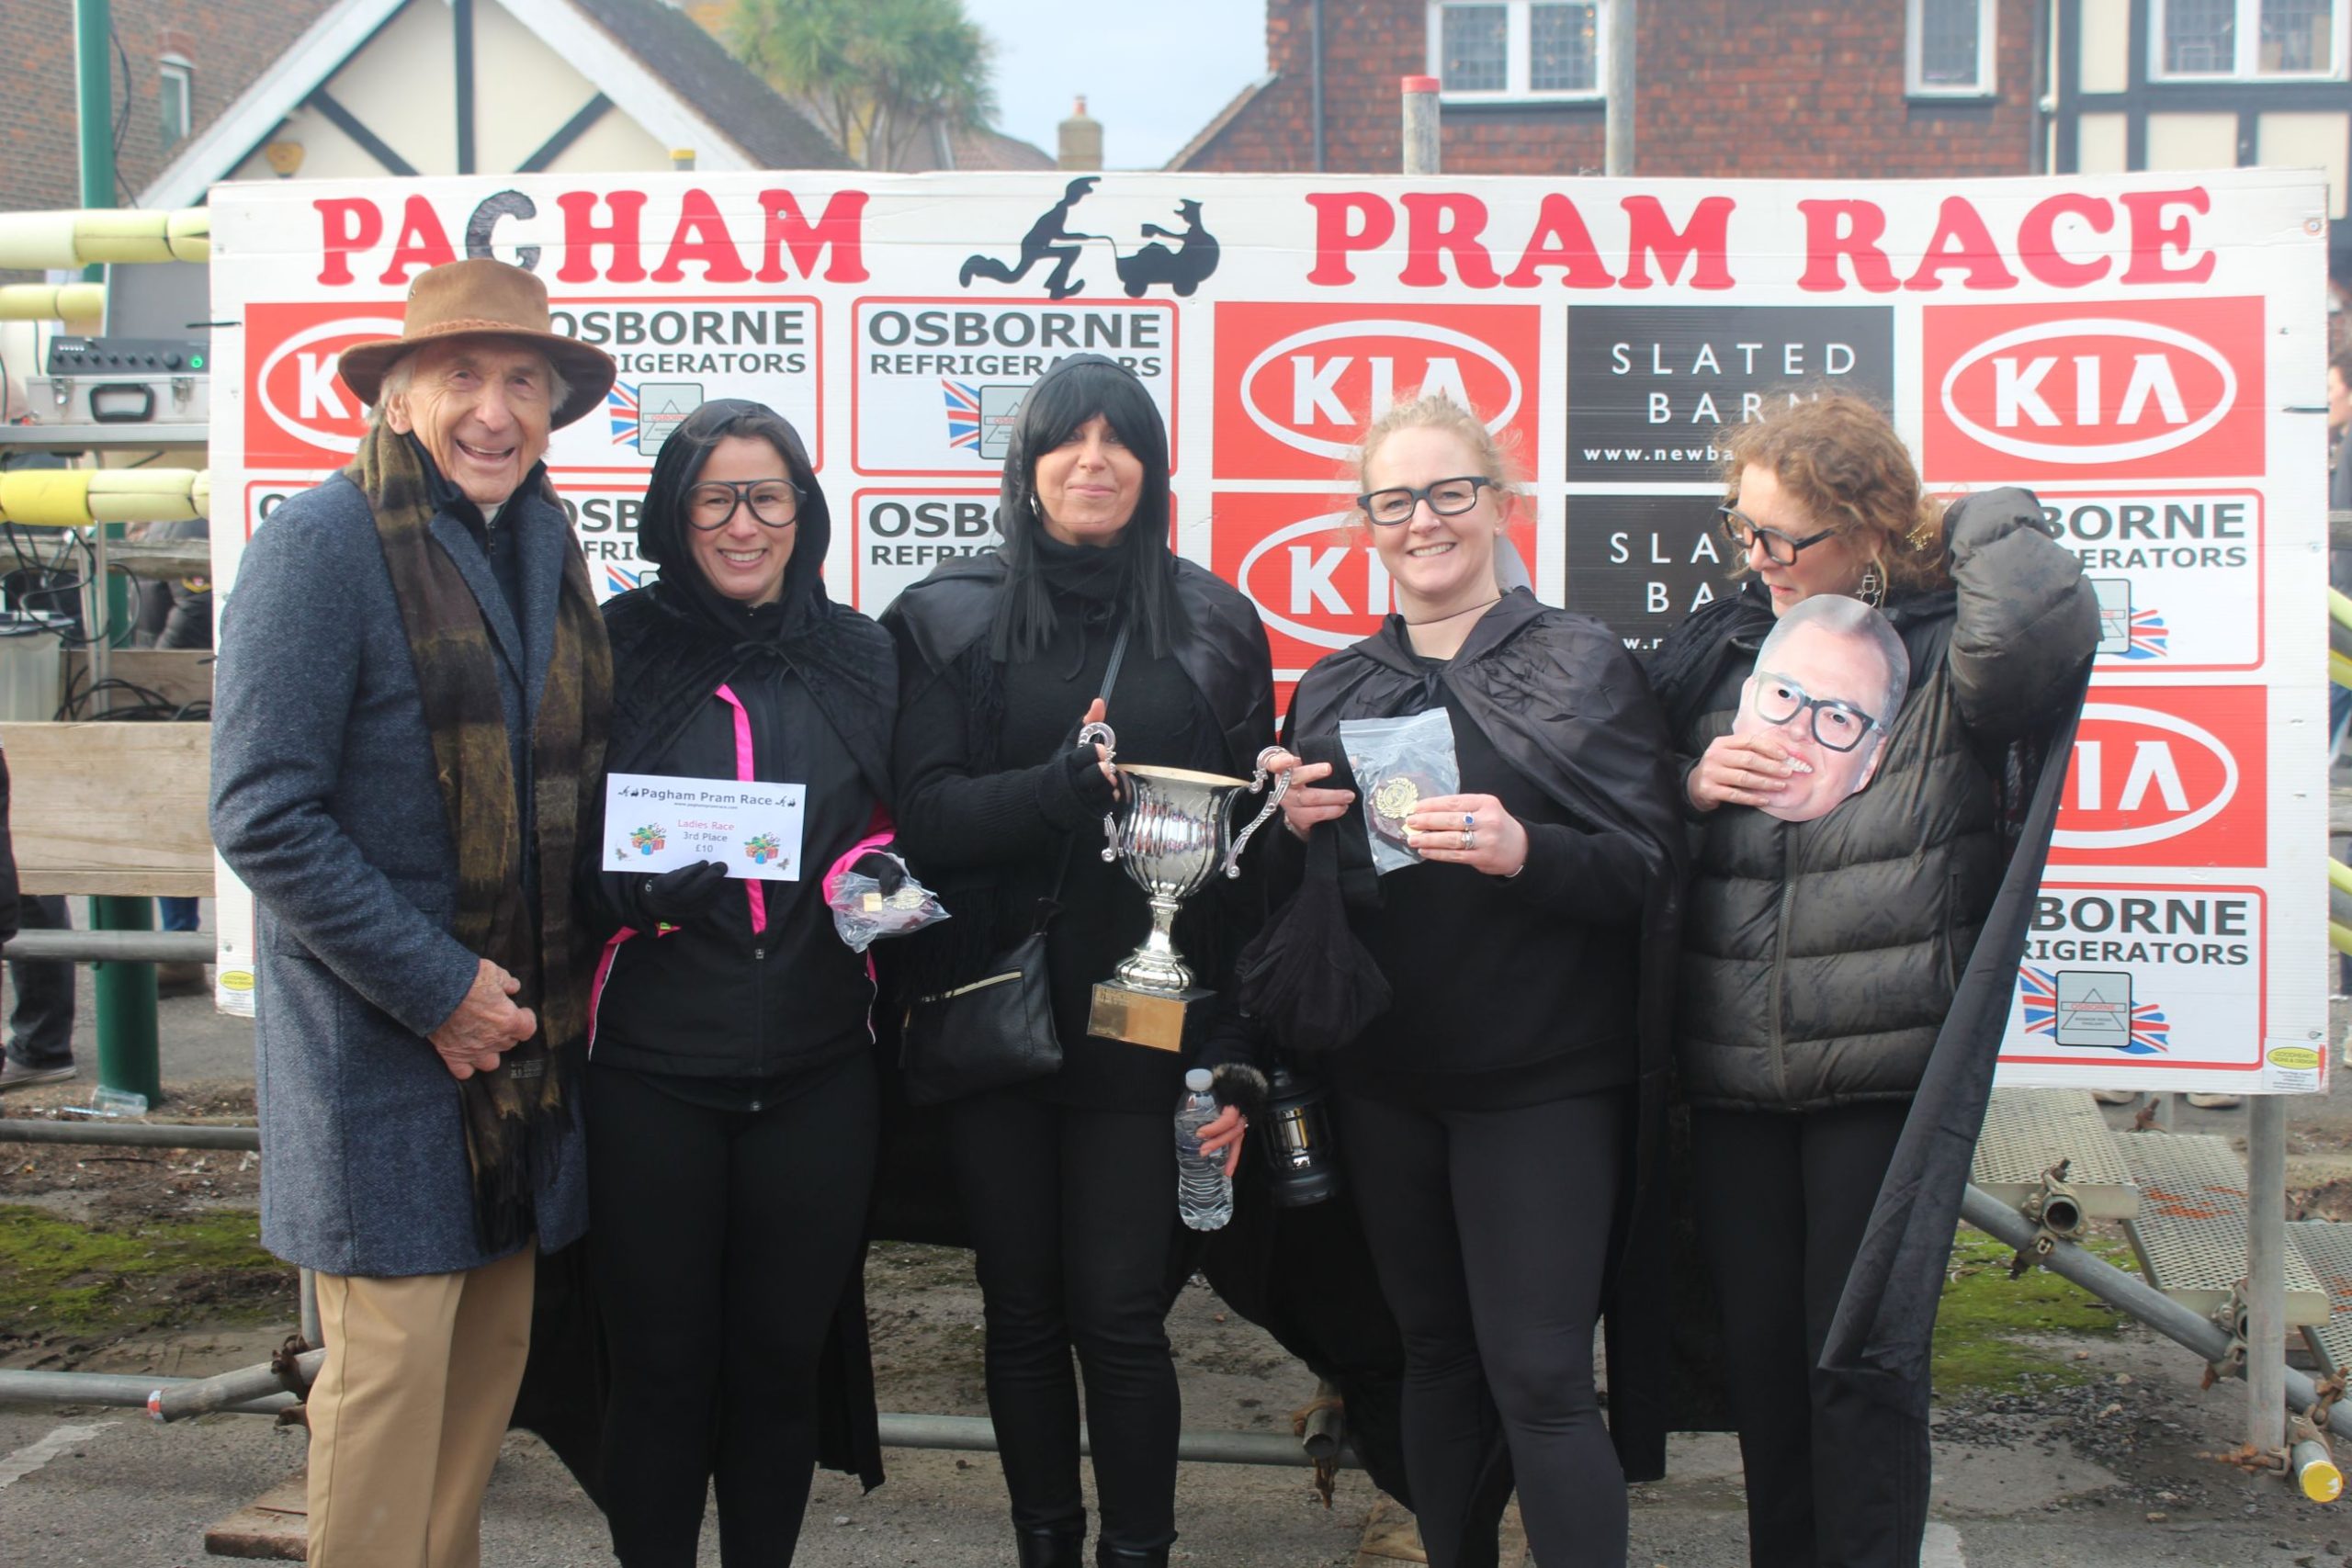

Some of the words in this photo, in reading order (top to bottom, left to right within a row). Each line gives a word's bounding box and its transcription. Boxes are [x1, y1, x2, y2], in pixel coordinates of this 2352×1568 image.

[313, 187, 871, 287] PAGHAM
[1305, 191, 1736, 289] PRAM
[1796, 186, 2216, 291] RACE
[868, 310, 1161, 349] OSBORNE
[1611, 343, 1856, 375] SLATED
[1991, 353, 2189, 427] KIA
[1648, 392, 1818, 424] BAR
[1583, 446, 1736, 461] www.newba
[1287, 546, 1390, 615] KI
[2072, 740, 2190, 812] IA
[640, 788, 695, 802] Pagham
[700, 792, 736, 803] Pram
[741, 795, 773, 806] Race
[677, 818, 708, 829] Ladies
[711, 821, 735, 830] Race
[683, 831, 699, 840] 3rd
[702, 833, 728, 842] Place
[695, 844, 713, 853] £10
[2029, 897, 2247, 935] BORNE
